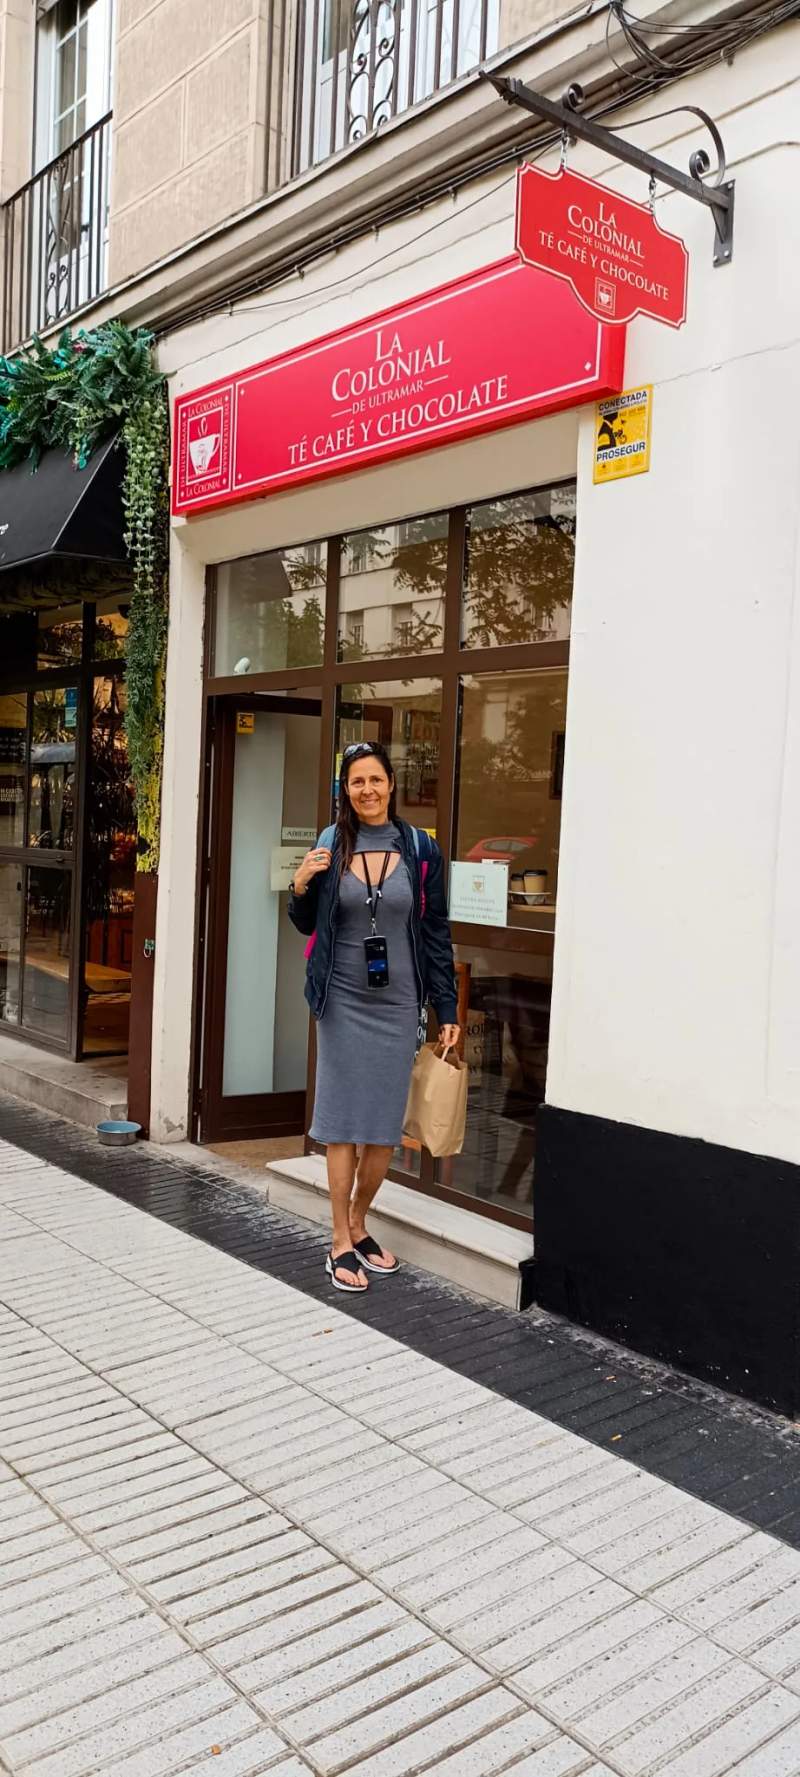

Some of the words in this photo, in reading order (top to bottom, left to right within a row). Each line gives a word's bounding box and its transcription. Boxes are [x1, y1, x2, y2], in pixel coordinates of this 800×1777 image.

[599, 202, 617, 228] LA
[567, 205, 645, 259] COLONIAL
[538, 230, 554, 249] TÉ
[557, 240, 587, 264] CAFÉ
[590, 254, 598, 268] Y
[600, 259, 670, 301] CHOCOLATE
[582, 235, 593, 247] DE
[594, 239, 630, 263] ULTRAMAR
[375, 330, 403, 361] LA
[331, 340, 451, 401] COLONIAL
[352, 401, 366, 415] DE
[368, 379, 424, 409] ULTRAMAR
[598, 391, 647, 411] CONECTADA
[288, 434, 307, 465] TÉ
[312, 419, 355, 457] CAFÉ
[360, 420, 373, 442] Y
[377, 375, 508, 437] CHOCOLATE
[596, 441, 646, 462] PROSEGUR
